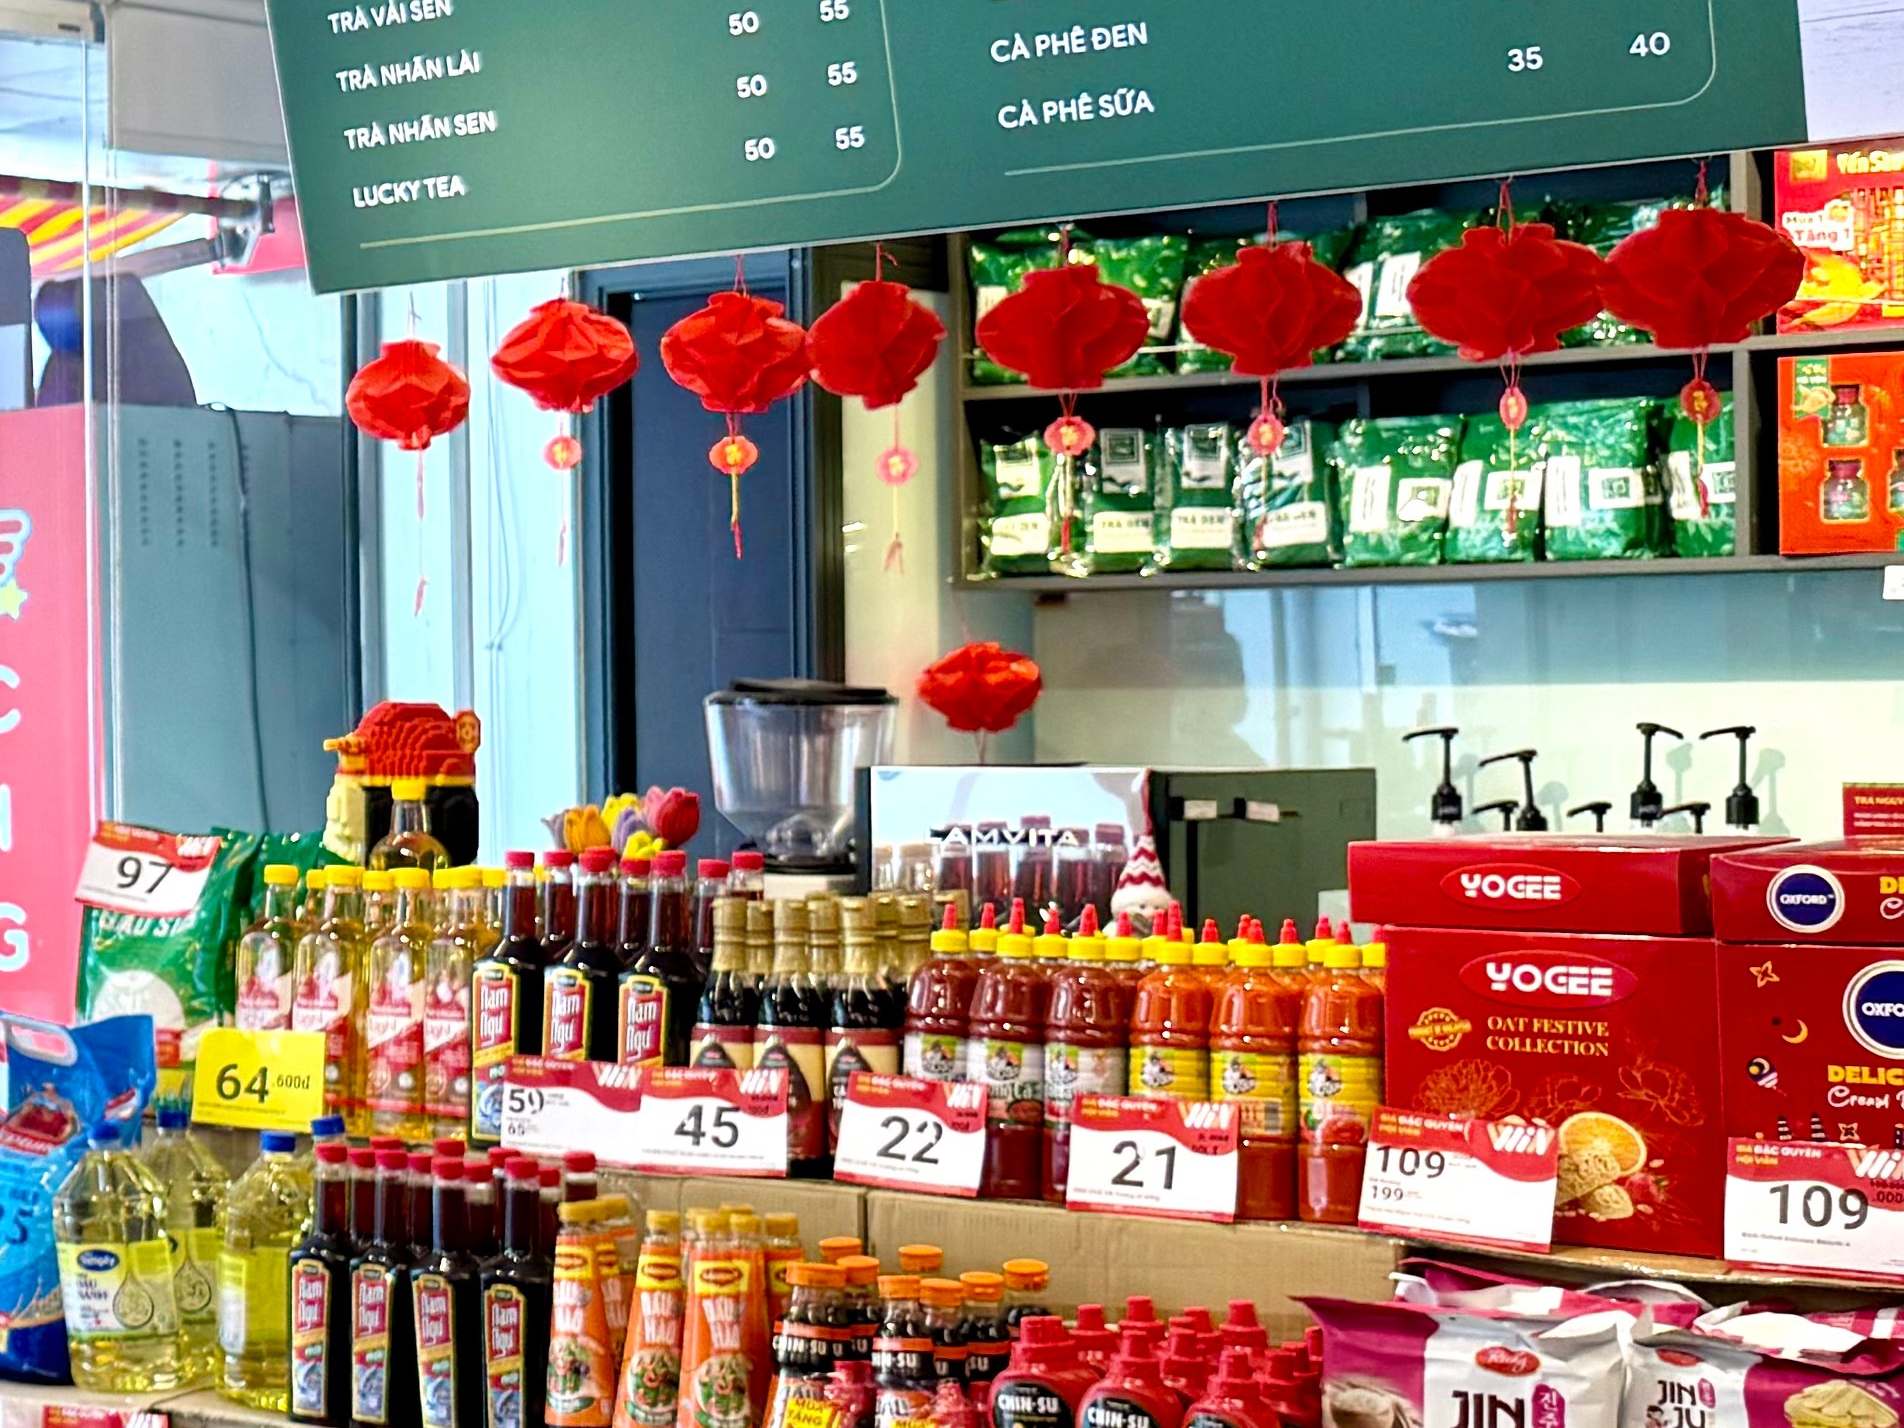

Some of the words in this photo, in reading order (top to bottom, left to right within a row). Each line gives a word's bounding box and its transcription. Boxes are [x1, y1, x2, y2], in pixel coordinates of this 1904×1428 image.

[327, 5, 369, 34] TRÀ
[728, 11, 760, 36] 50
[990, 32, 1031, 63] CÀ
[1034, 25, 1087, 58] PHÊ
[1090, 21, 1148, 51] ĐEN
[1629, 31, 1671, 57] 40
[827, 61, 858, 86] 55
[1507, 46, 1544, 72] 35
[335, 63, 378, 92] TRÀ
[736, 74, 768, 99] 50
[997, 98, 1039, 129] CÀ
[1042, 92, 1095, 124] PHÊ
[1098, 87, 1155, 118] SỮA
[343, 121, 386, 150] TRÀ
[453, 110, 499, 136] SEN
[835, 125, 865, 150] 55
[744, 137, 776, 162] 50
[352, 179, 421, 208] LUCKY
[422, 174, 467, 199] TEA
[117, 856, 174, 894] 97
[1461, 873, 1562, 899] YOGEE
[1486, 962, 1613, 996] YOGEE
[1487, 1016, 1527, 1035] OAT
[1532, 1017, 1609, 1037] FESTIVE
[1486, 1037, 1609, 1057] COLLECTION
[216, 1063, 270, 1104] 64
[675, 1104, 740, 1148] 45
[876, 1115, 943, 1165] 22
[1111, 1140, 1177, 1190] 21
[1377, 1146, 1445, 1178] 109
[1371, 1185, 1404, 1202] 199
[1769, 1183, 1869, 1230] 109
[998, 1394, 1059, 1414] CHIN-SU
